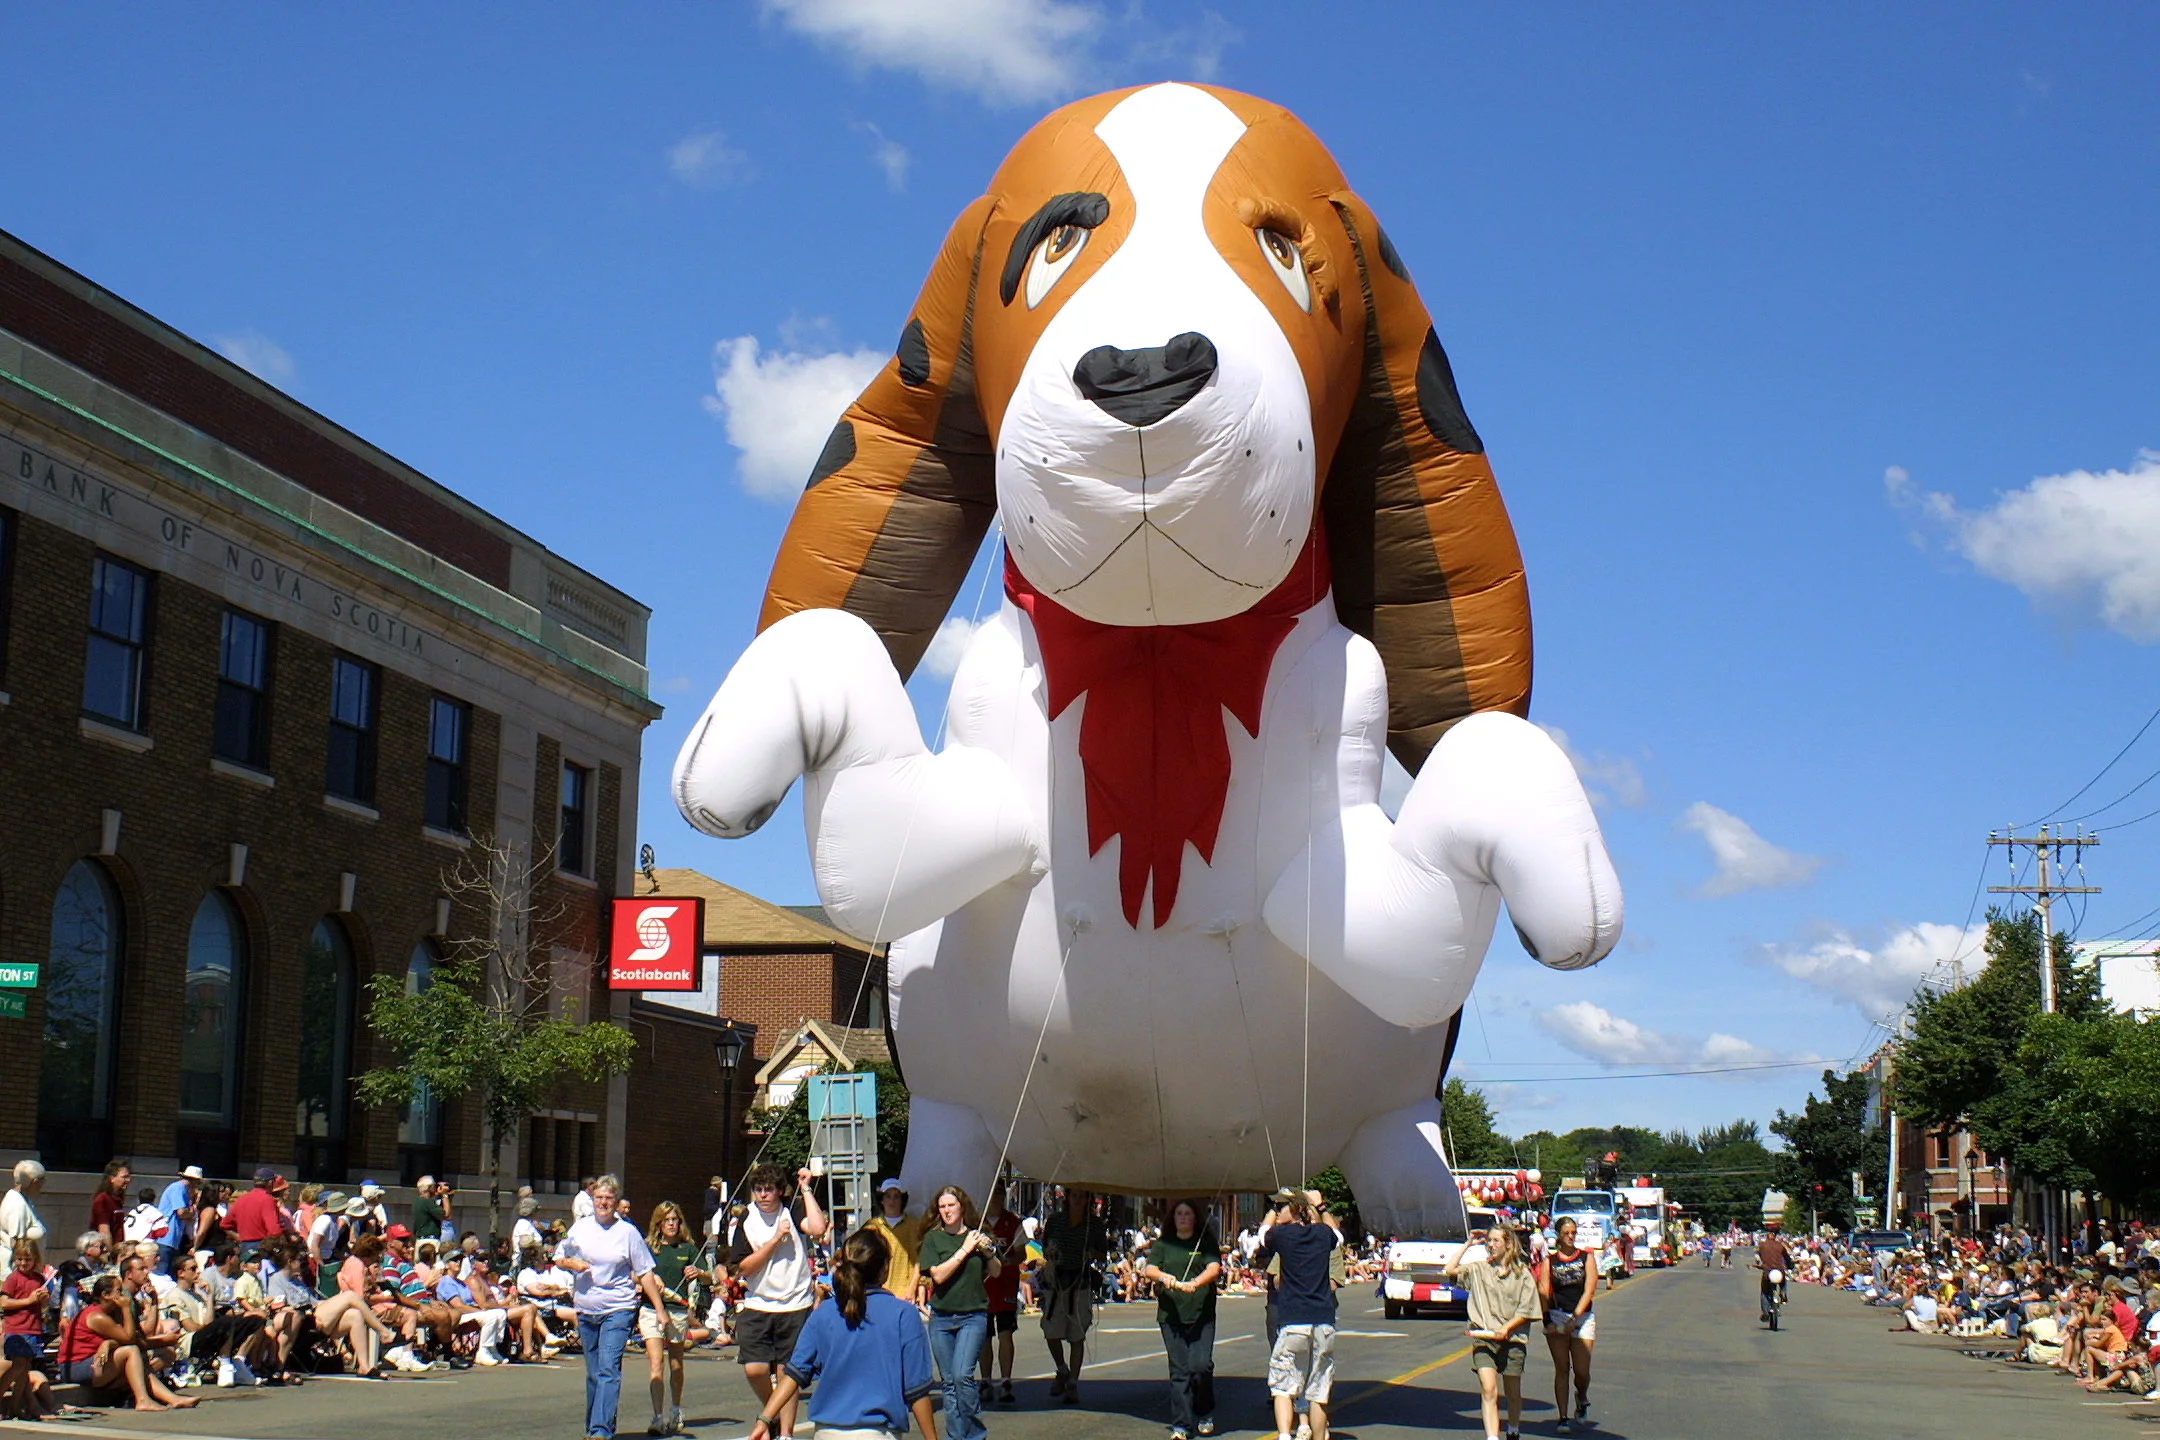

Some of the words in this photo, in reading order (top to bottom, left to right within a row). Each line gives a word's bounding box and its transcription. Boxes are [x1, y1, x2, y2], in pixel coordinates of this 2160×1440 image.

[19, 451, 116, 517] BANK
[161, 517, 193, 549] OF
[226, 545, 302, 602] NOVA
[332, 595, 424, 656] SCOTIA
[23, 971, 35, 981] ST
[612, 968, 691, 981] Scotiabank
